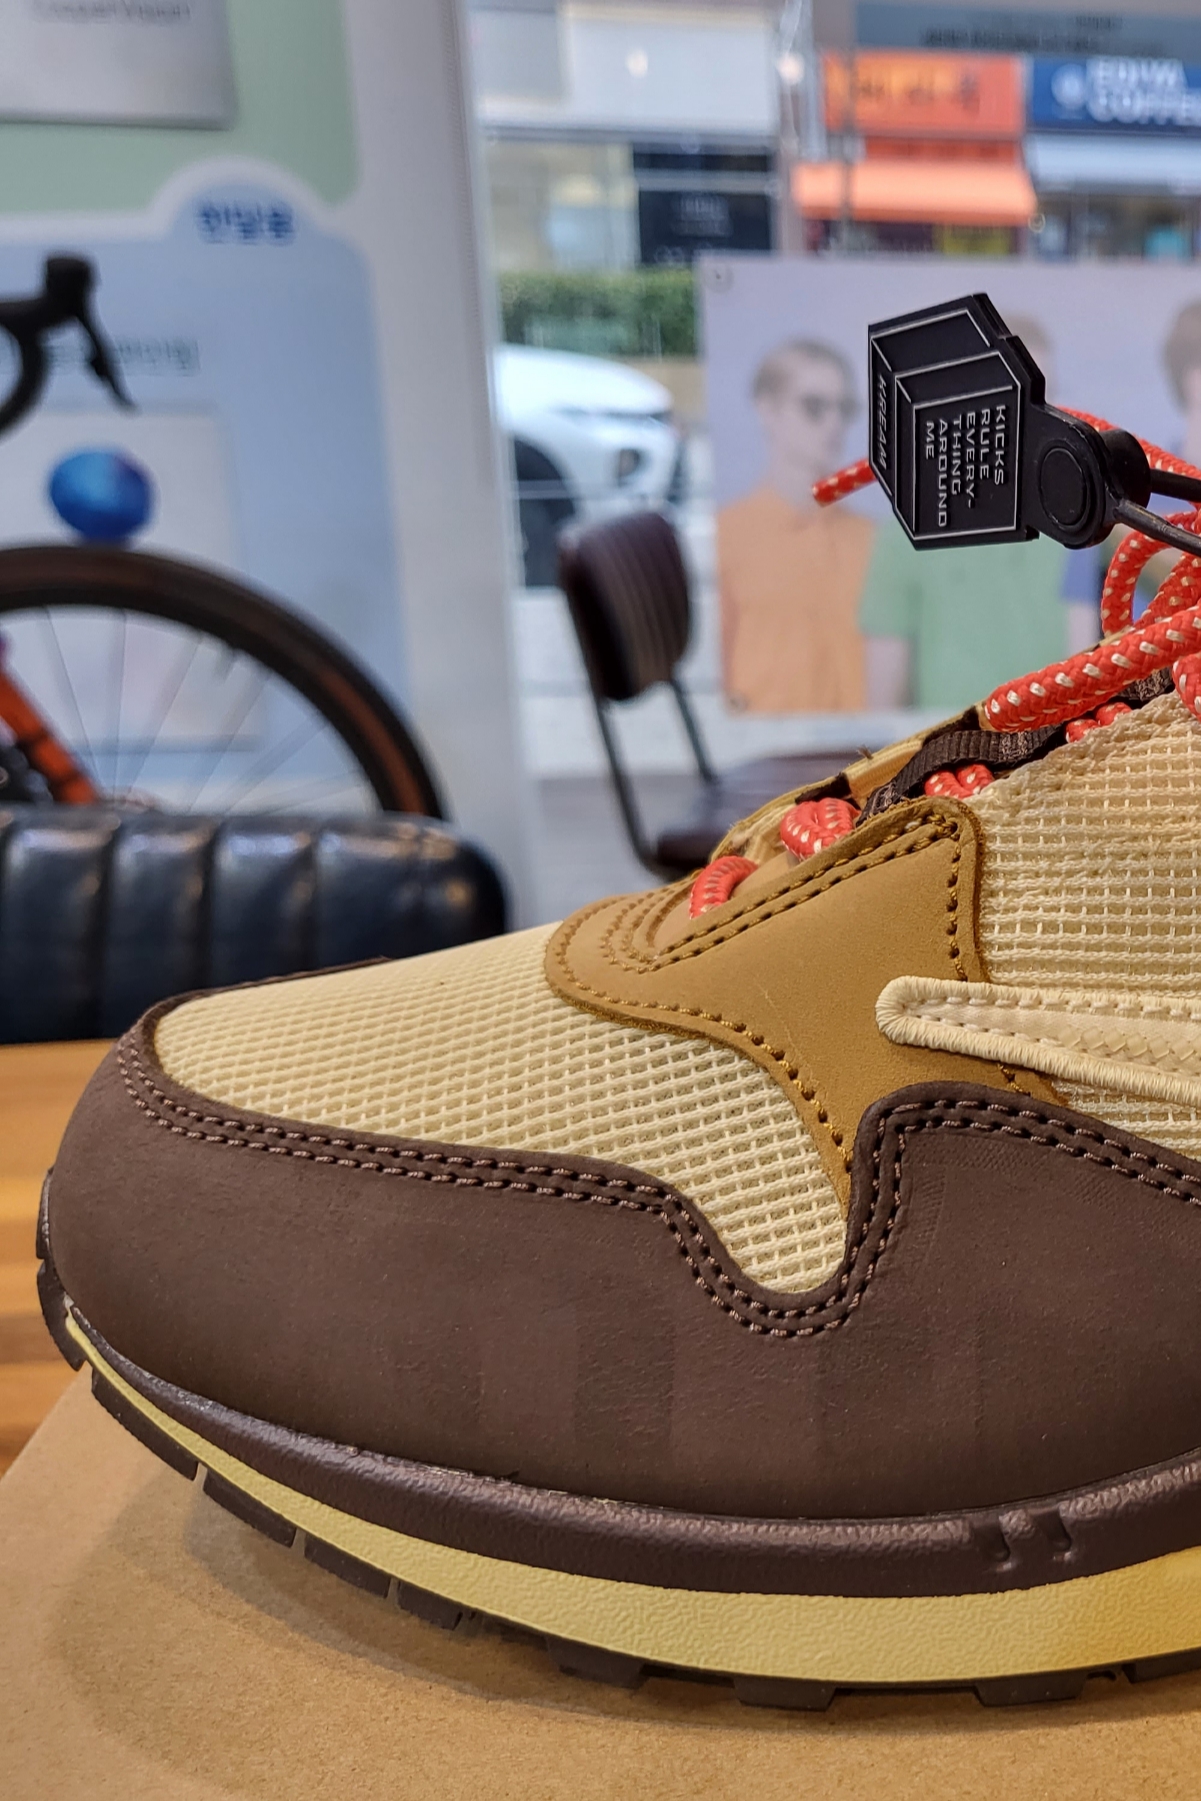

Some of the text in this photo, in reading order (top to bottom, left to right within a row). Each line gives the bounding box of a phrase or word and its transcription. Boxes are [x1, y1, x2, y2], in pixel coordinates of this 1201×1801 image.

[878, 374, 888, 471] KREAM
[925, 420, 935, 460] ME
[951, 414, 962, 495] THING
[966, 411, 976, 509] EVERY-
[980, 408, 991, 480] RULE
[994, 404, 1006, 486] KICKS
[938, 418, 949, 528] AROUND
